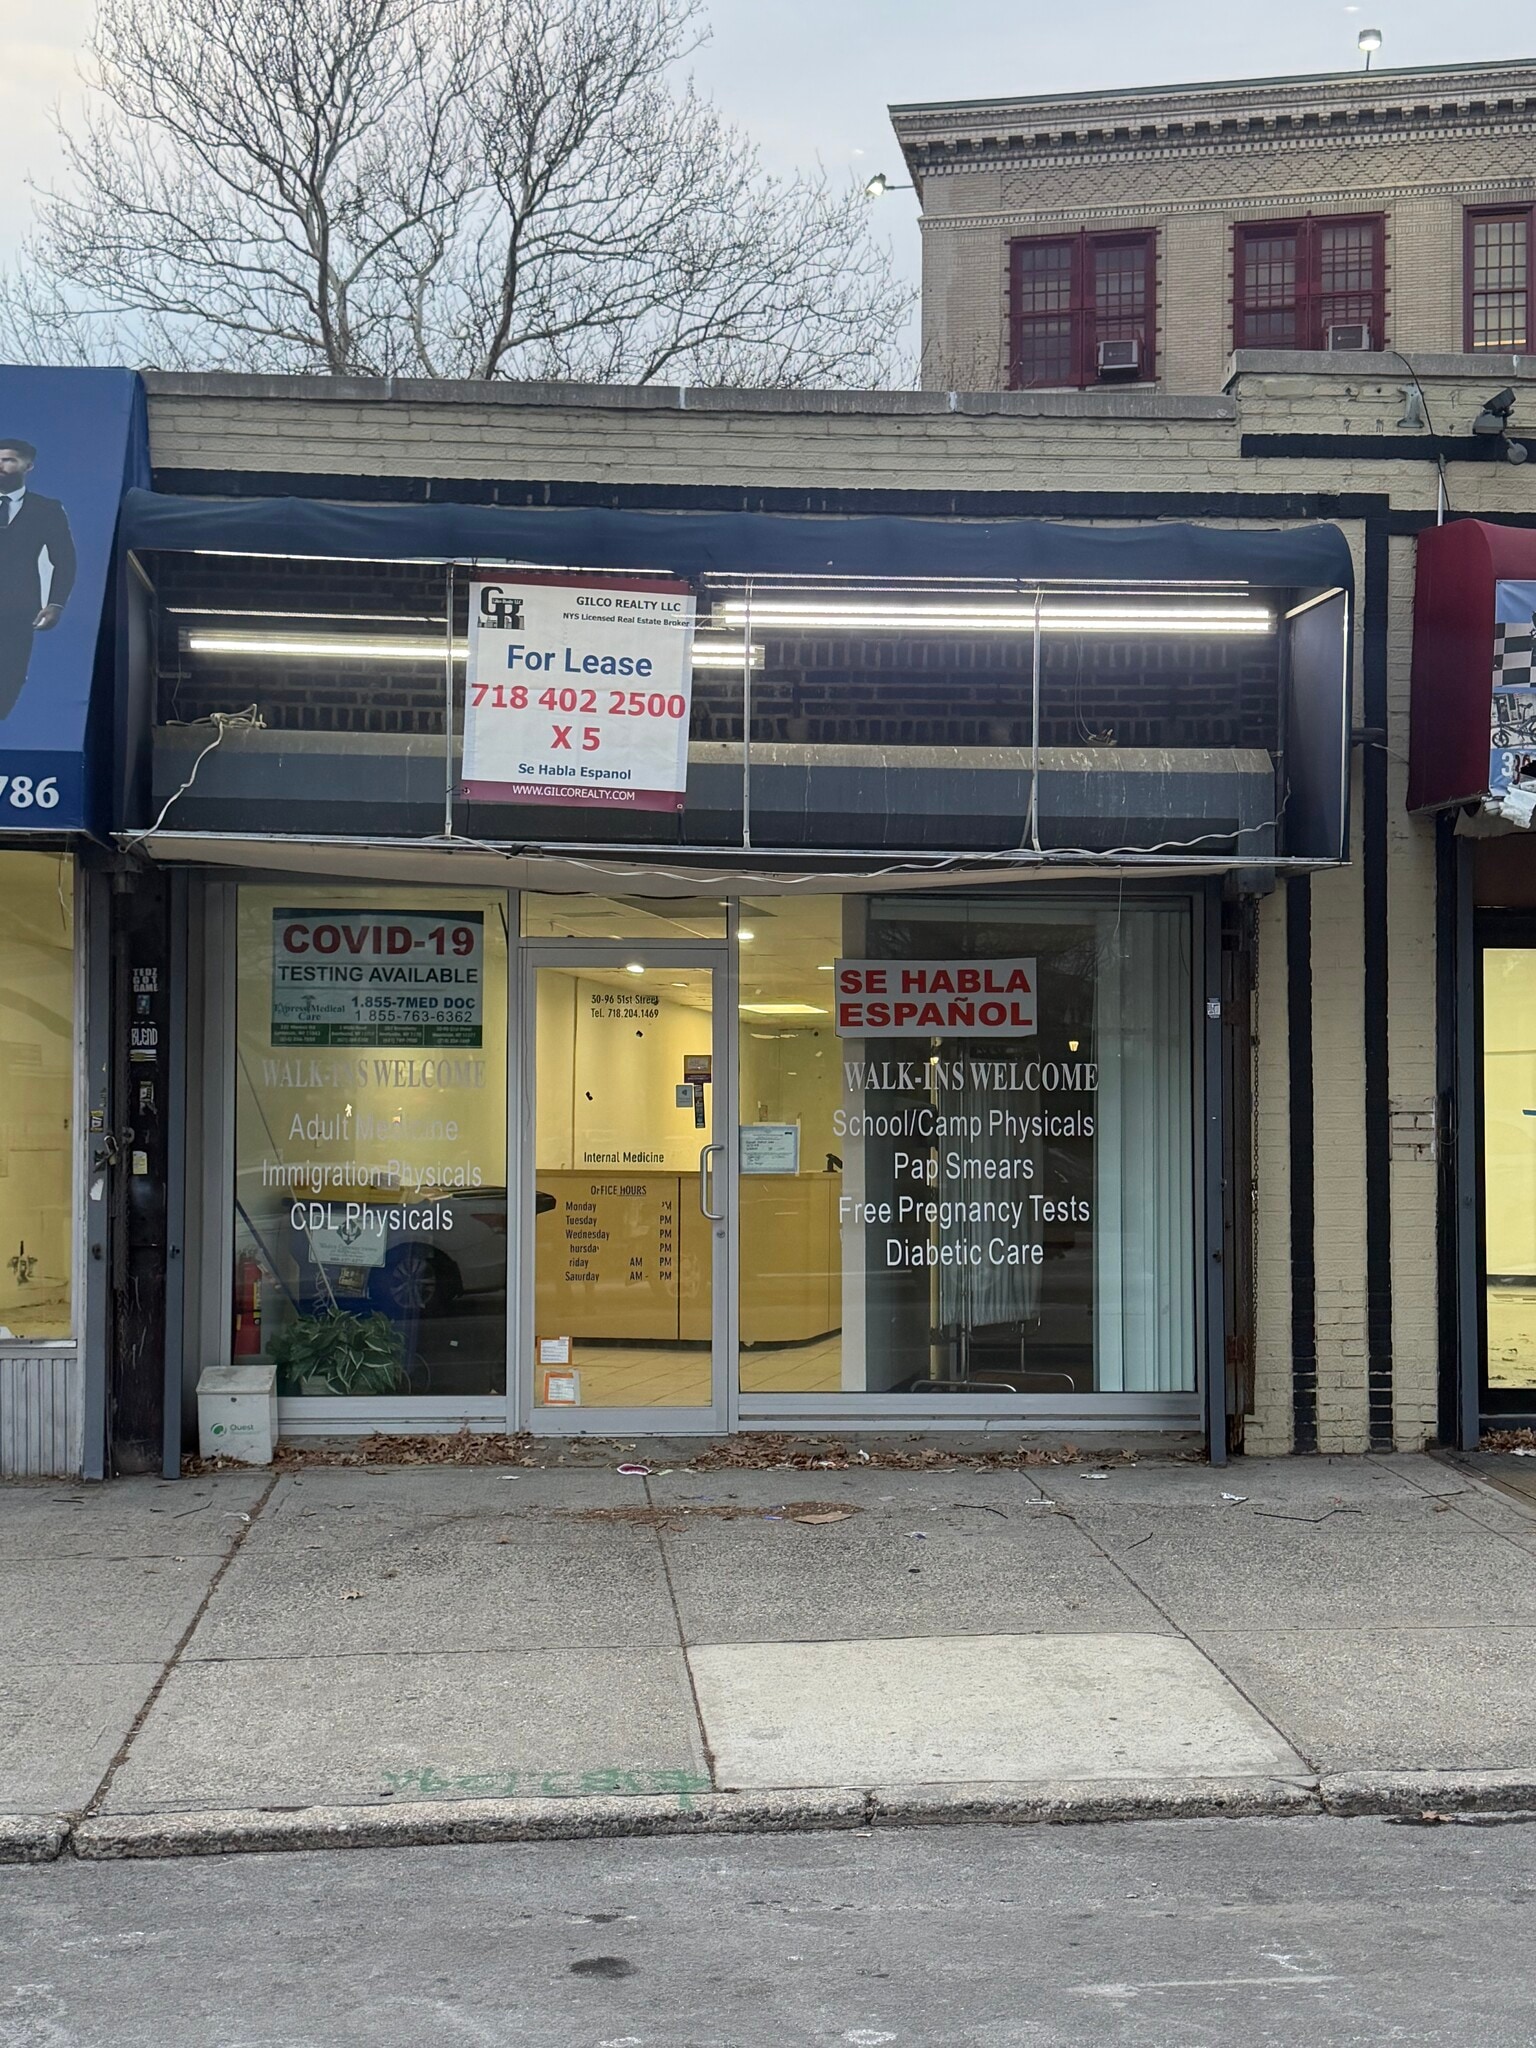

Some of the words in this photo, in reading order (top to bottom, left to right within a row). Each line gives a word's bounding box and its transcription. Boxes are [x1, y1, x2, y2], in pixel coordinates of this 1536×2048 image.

[576, 596, 612, 607] GILCO
[615, 599, 657, 610] REALTY
[661, 602, 681, 612] LLC
[563, 612, 580, 620] NYS
[581, 613, 615, 622] Licensed
[617, 616, 635, 624] Real
[637, 617, 661, 626] Estate
[663, 619, 690, 627] Broker
[507, 644, 555, 672] For
[564, 648, 653, 677] Lease
[471, 683, 528, 710] 718
[538, 687, 597, 713] 402
[608, 691, 686, 719] 2500
[550, 725, 573, 750] X
[582, 727, 600, 751] 5
[518, 763, 535, 775] Se
[538, 764, 576, 777] Habla
[580, 766, 632, 780] Espanol
[512, 784, 635, 801] WWW.GILCOREALTY.COM
[283, 924, 475, 956] COVID-19
[278, 965, 363, 982] TESTING
[368, 967, 478, 984] AVAILABLE
[839, 969, 887, 994] SE
[901, 969, 1032, 994] HABLA
[352, 996, 438, 1009] 1.855-7MED
[443, 997, 476, 1009] DOC
[591, 994, 614, 1004] 30-96
[617, 994, 633, 1004] 51st
[298, 1012, 321, 1021] Care
[310, 1004, 345, 1013] Medical
[355, 1010, 472, 1023] 1.855-763-6362
[591, 1008, 605, 1018] Tel.
[607, 1008, 659, 1018] 718.204.1469
[839, 996, 1033, 1027] ESPAÑOL
[131, 1028, 158, 1046] BLEND
[262, 1059, 368, 1089] WALK-INS
[373, 1059, 486, 1089] WELCOME
[843, 1061, 965, 1091] WALK-INS
[969, 1062, 1100, 1091] WELCOME
[288, 1113, 349, 1141] Adult
[832, 1109, 982, 1143] School/Camp
[989, 1109, 1095, 1143] Physicals
[583, 1152, 620, 1163] Internal
[623, 1152, 664, 1163] Medicine
[262, 1159, 381, 1193] Immigration
[387, 1160, 482, 1193] Physicals
[894, 1152, 939, 1186] Pap
[946, 1152, 1035, 1180] Smears
[565, 1201, 597, 1212] Monday
[839, 1196, 892, 1224] Free
[899, 1195, 1024, 1230] Pregnancy
[1029, 1195, 1091, 1222] Tests
[290, 1202, 339, 1231] CDL
[346, 1202, 454, 1237] Physicals
[566, 1215, 597, 1227] Tuesday
[660, 1215, 672, 1225] PM
[565, 1229, 610, 1241] Wednesday
[660, 1229, 672, 1239] PM
[660, 1243, 672, 1253] PM
[886, 1238, 982, 1267] Diabetic
[988, 1237, 1044, 1266] Care
[629, 1257, 643, 1267] AM
[660, 1257, 672, 1267] PM
[629, 1271, 643, 1281] AM
[660, 1271, 672, 1281] PM
[230, 1423, 254, 1431] Quest
